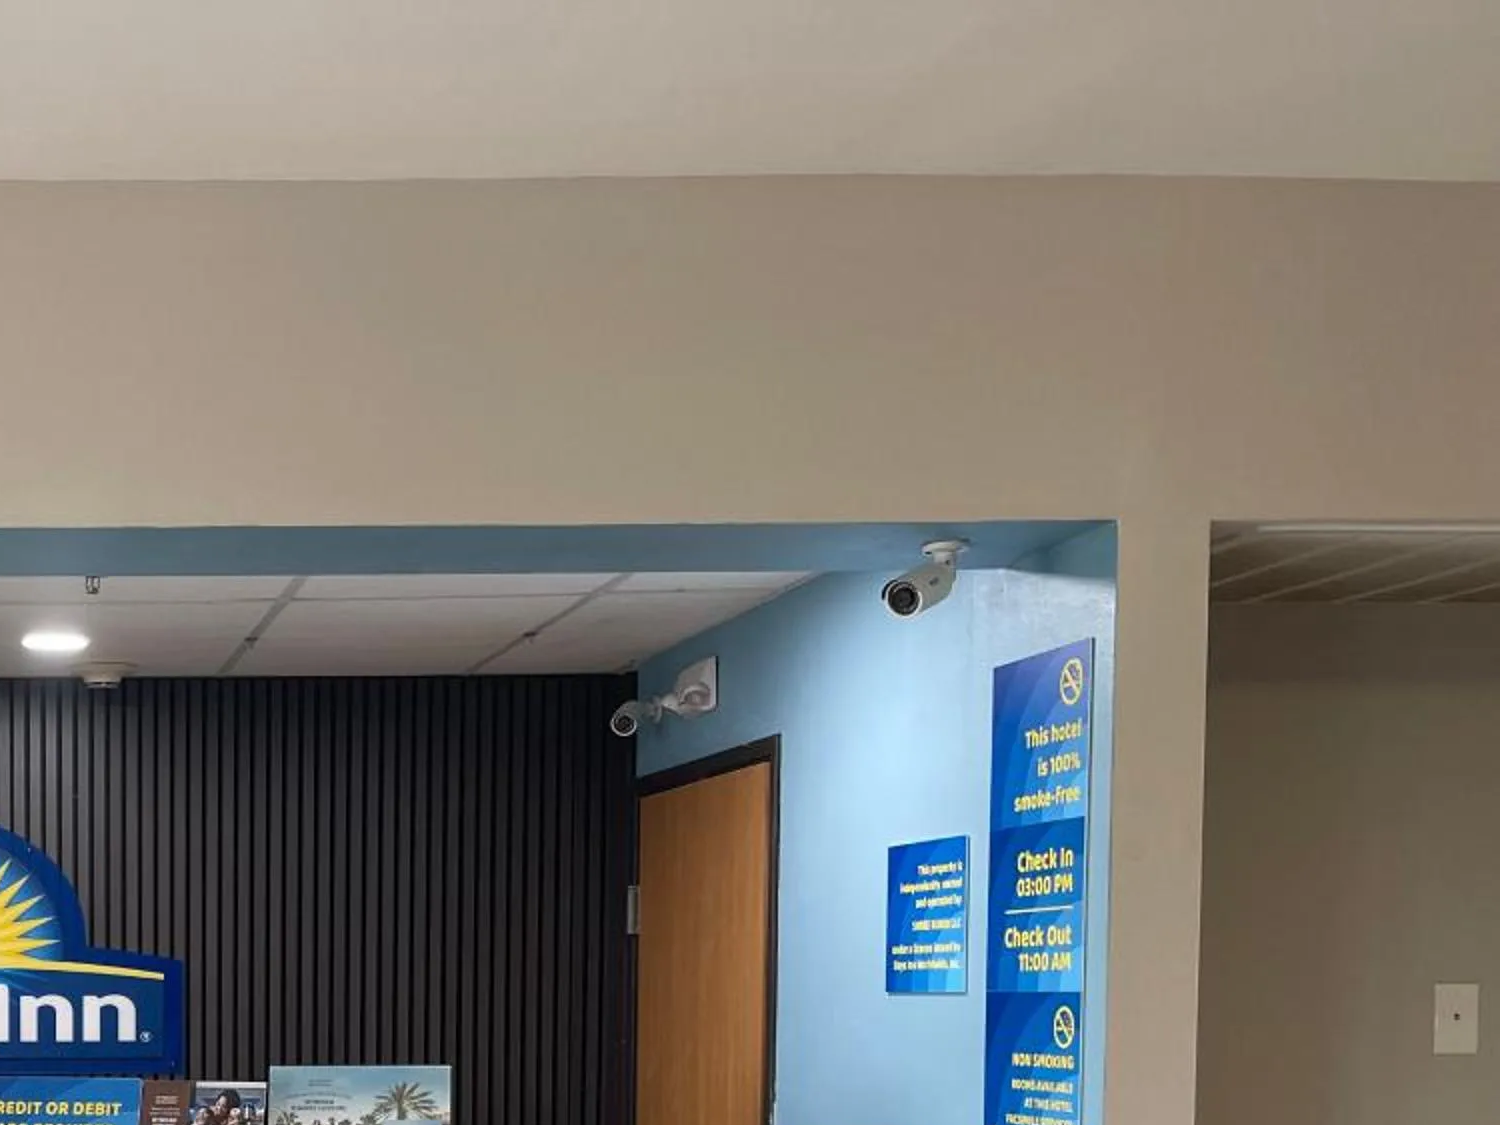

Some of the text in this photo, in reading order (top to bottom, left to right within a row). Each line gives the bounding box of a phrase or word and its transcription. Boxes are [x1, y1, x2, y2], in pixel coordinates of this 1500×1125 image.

[1025, 717, 1081, 750] This hotel
[1038, 752, 1081, 777] is 100%
[1017, 848, 1073, 873] Check In
[1016, 873, 1073, 897] 03:00 PM
[1004, 924, 1072, 948] Check Out
[1018, 952, 1072, 972] 11:00 AM
[1012, 1053, 1075, 1069] NON SMOKING
[46, 1101, 69, 1116] OR
[73, 1102, 123, 1117] DEBIT
